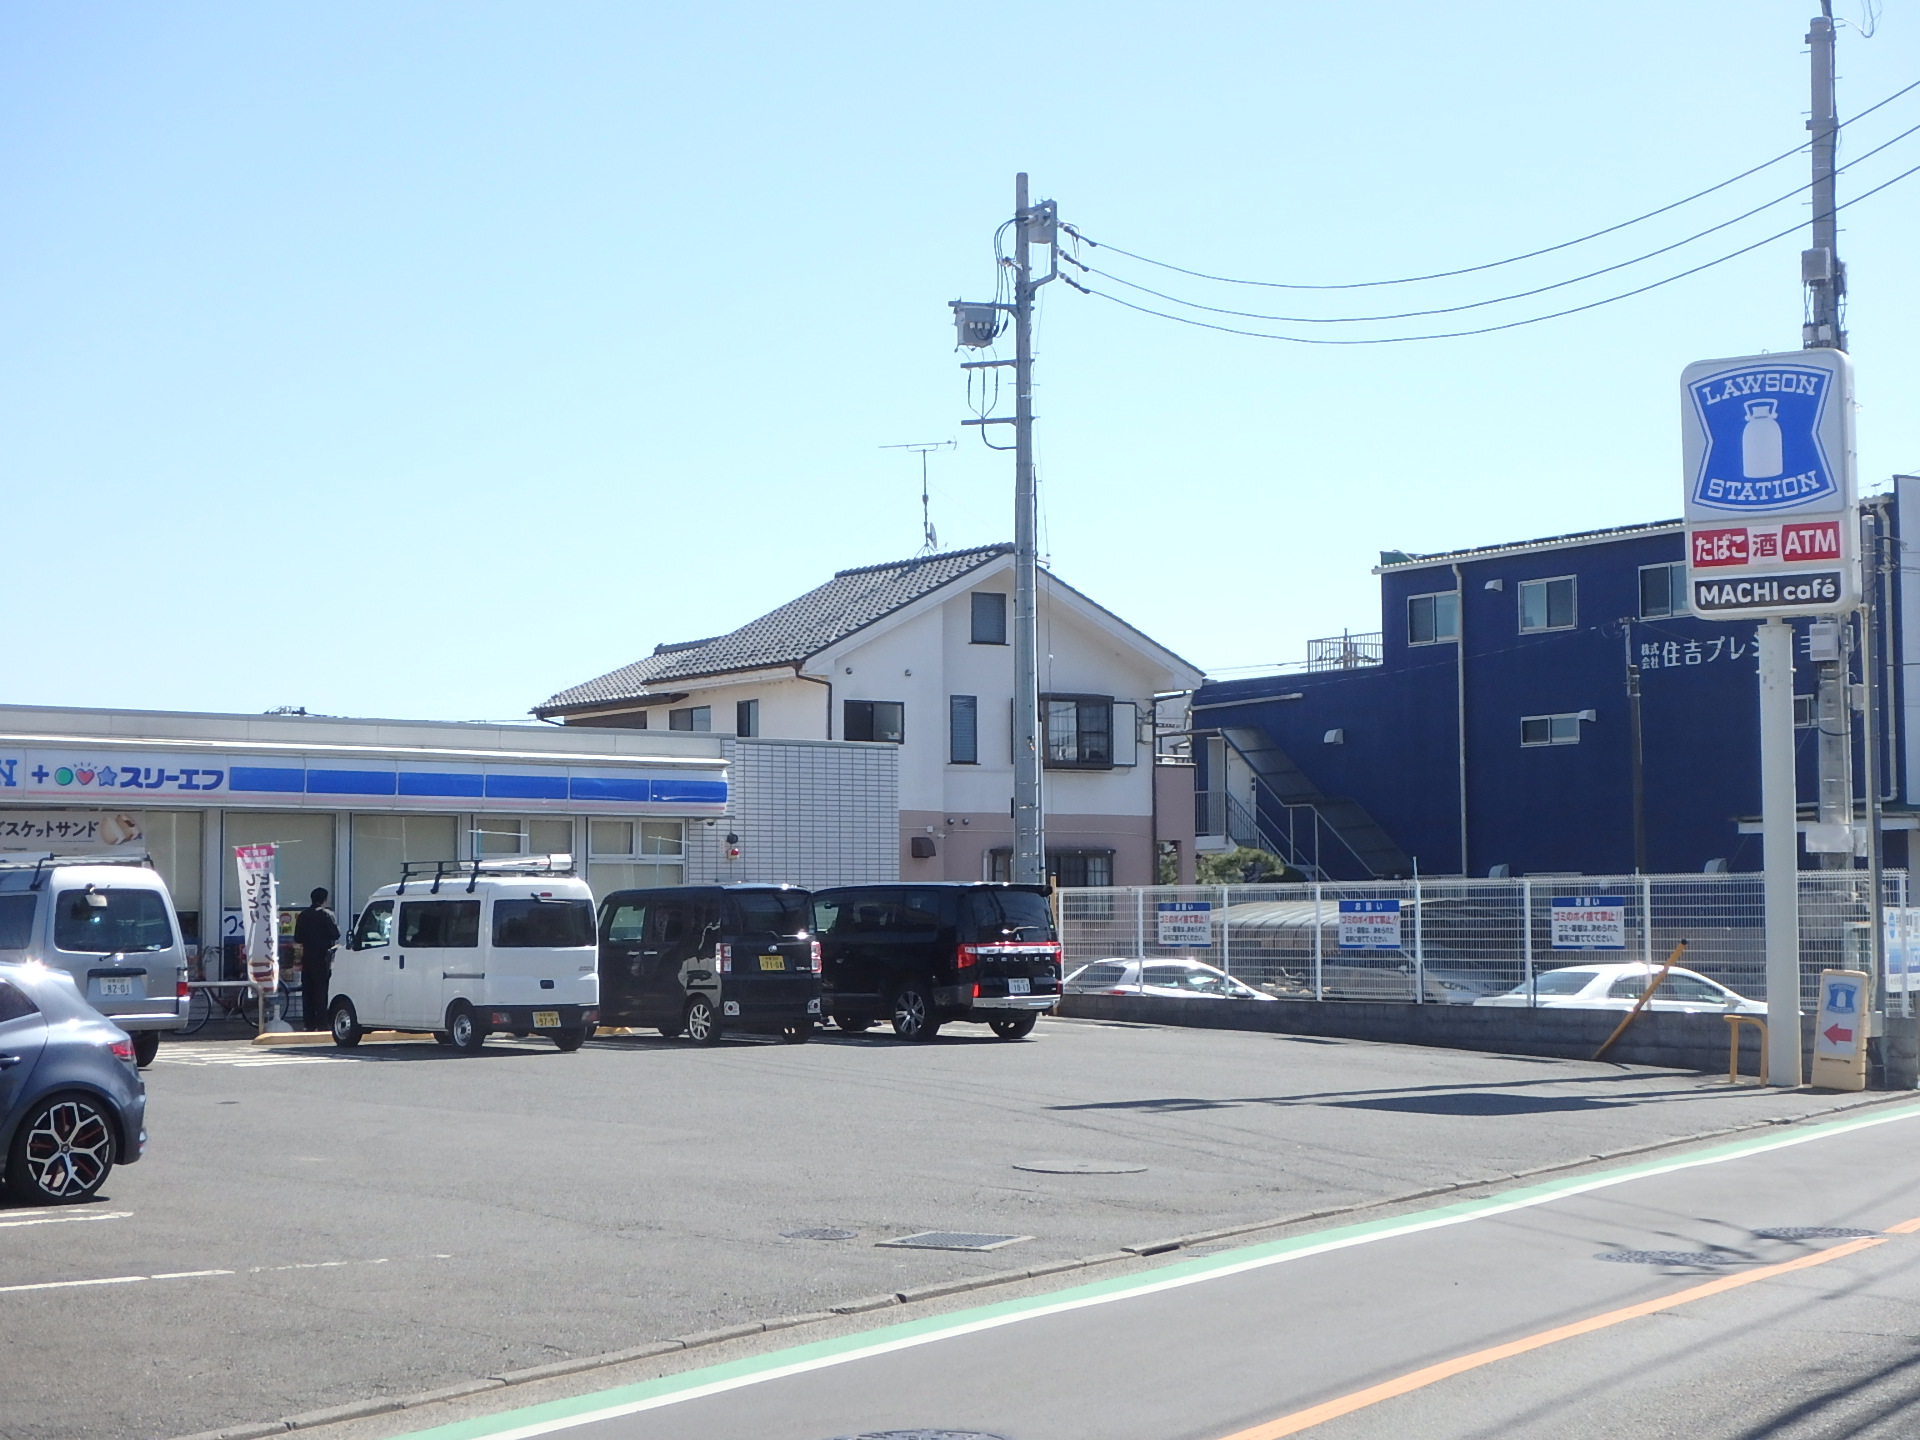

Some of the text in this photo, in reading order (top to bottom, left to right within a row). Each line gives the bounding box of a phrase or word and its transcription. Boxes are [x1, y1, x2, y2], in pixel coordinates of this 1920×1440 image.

[1702, 373, 1818, 406] LAWSON
[1707, 470, 1821, 501] STATION
[1695, 528, 1837, 562] たばこ 酒 ATM
[1700, 578, 1836, 605] MACHI café
[119, 766, 225, 791] スリーエフ
